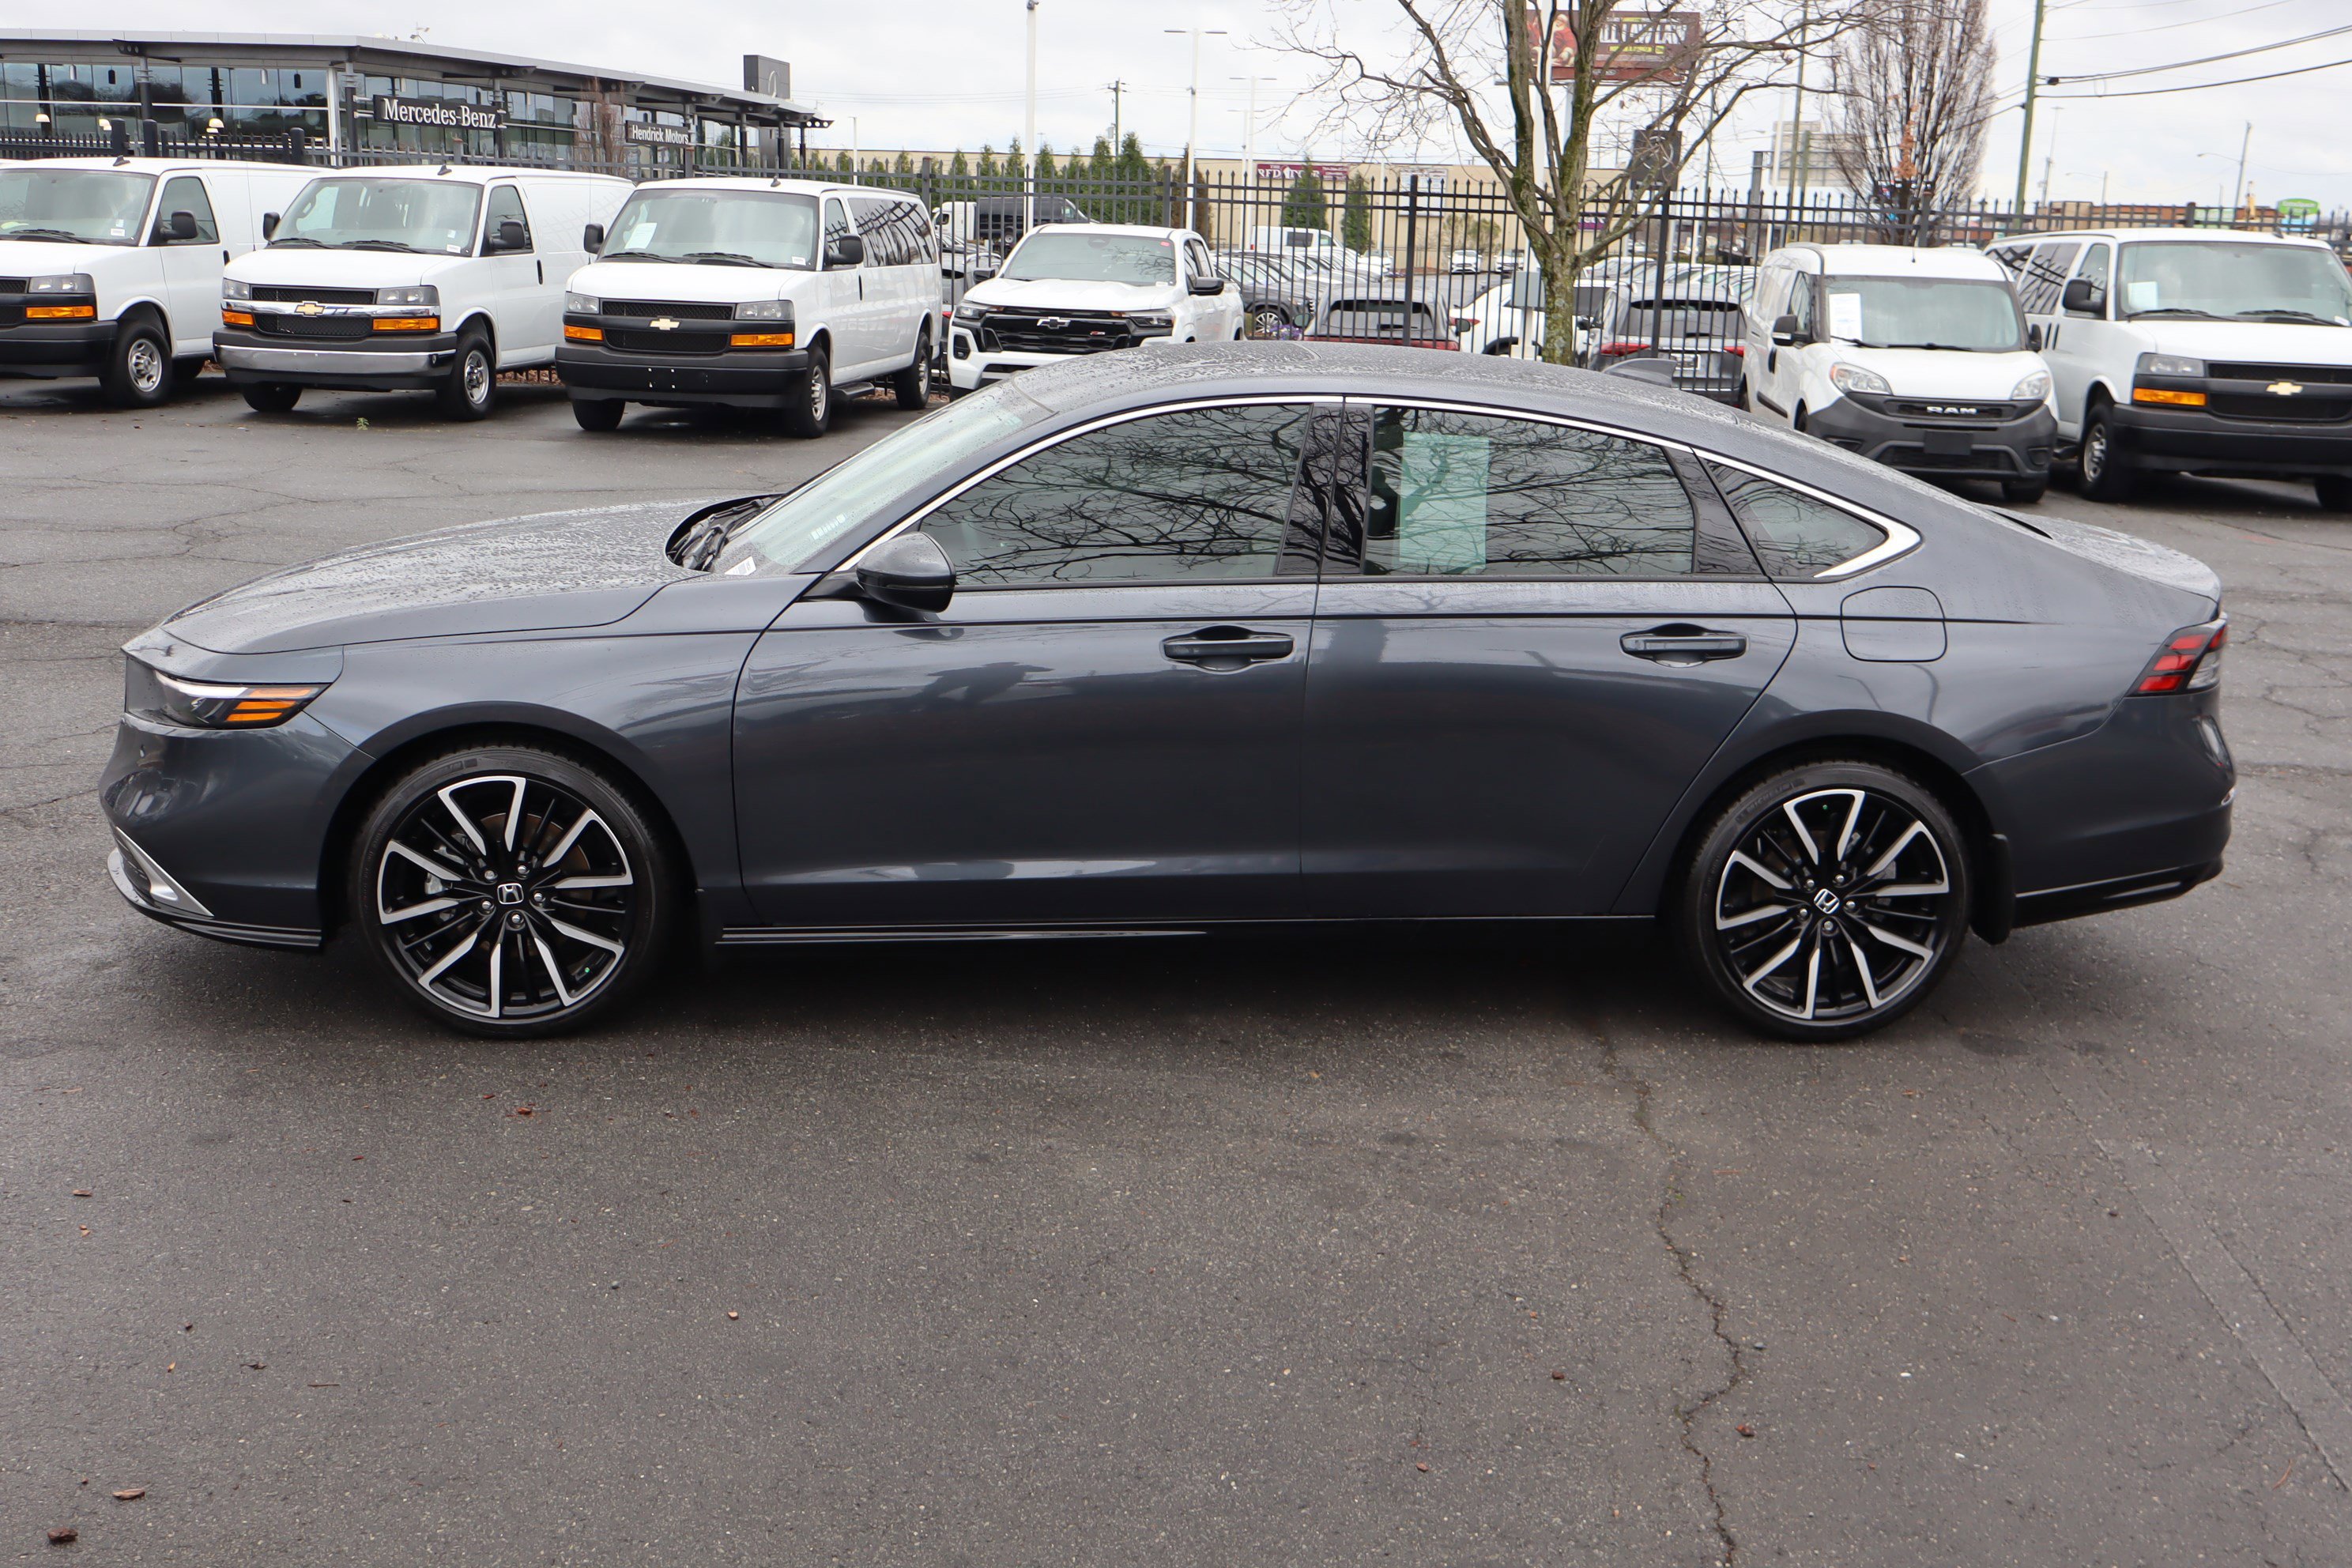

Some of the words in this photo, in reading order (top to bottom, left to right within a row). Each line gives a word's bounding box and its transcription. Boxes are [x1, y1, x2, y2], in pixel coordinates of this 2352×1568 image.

[383, 98, 496, 129] Mercedes-Benz
[632, 124, 664, 142] Hendrick
[665, 128, 689, 145] Motors
